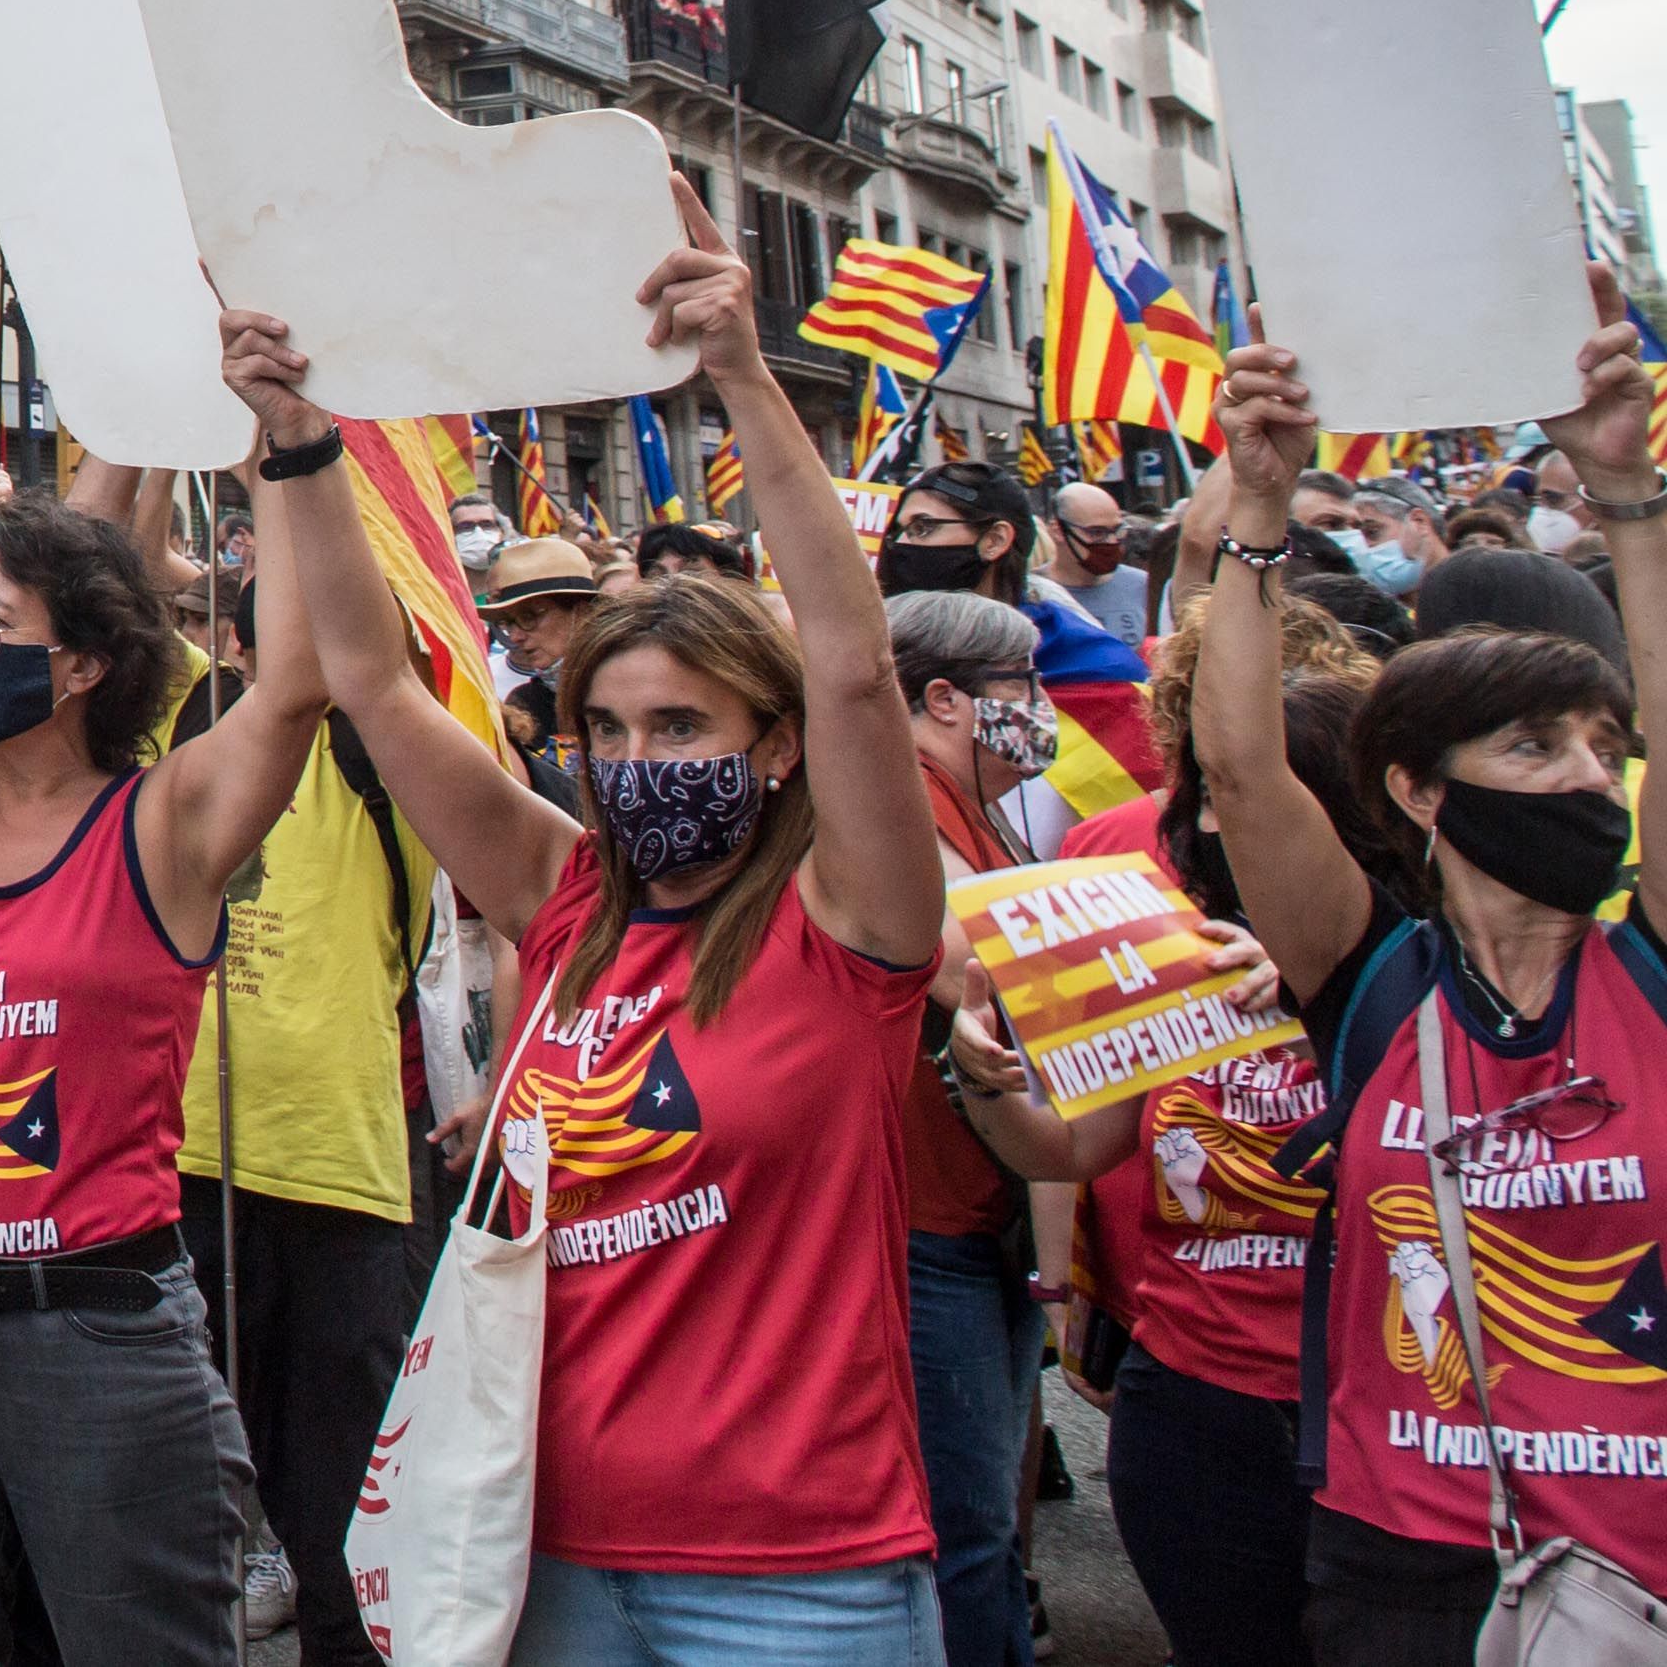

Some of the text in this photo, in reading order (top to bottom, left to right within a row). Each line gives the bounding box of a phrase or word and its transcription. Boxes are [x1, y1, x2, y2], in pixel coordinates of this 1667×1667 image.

[836, 488, 889, 533] EM
[987, 869, 1177, 959] EXIGIM
[1099, 939, 1158, 994] LA
[1461, 1155, 1646, 1210] GUANYEM
[547, 1184, 728, 1269] NDEPENDÈNCIA
[1173, 1234, 1309, 1271] LA INDEPEN
[1388, 1409, 1667, 1478] LA INDPENDÈNC
